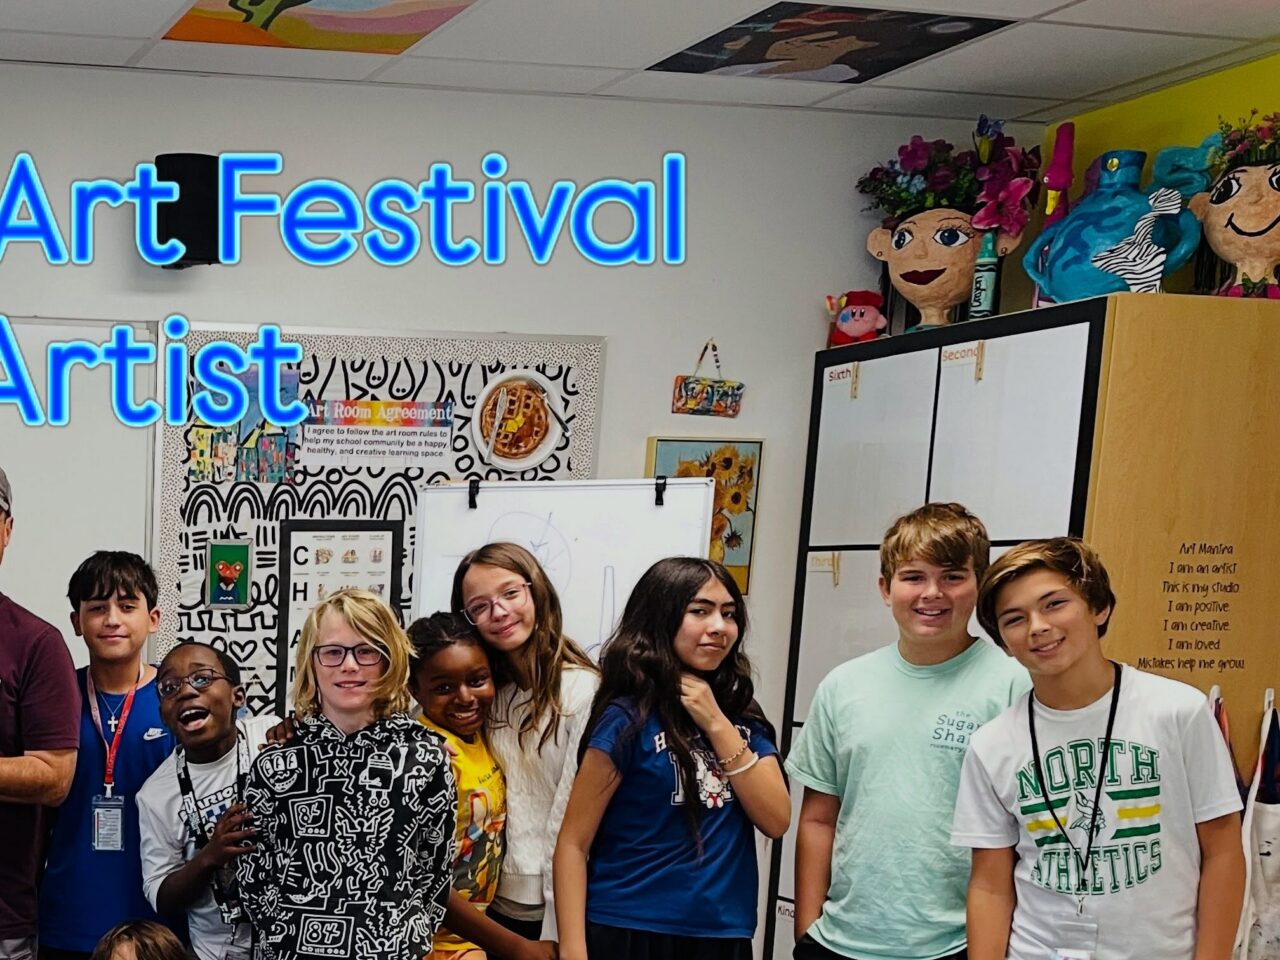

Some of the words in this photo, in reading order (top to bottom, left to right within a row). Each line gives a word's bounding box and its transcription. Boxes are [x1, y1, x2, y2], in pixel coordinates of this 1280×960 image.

[829, 368, 852, 382] Sixth
[308, 403, 329, 418] Art
[333, 403, 371, 419] Room
[378, 404, 454, 422] Agreement
[312, 428, 335, 438] agree
[347, 428, 370, 436] follow
[371, 428, 383, 436] the
[387, 429, 397, 437] art
[419, 429, 438, 438] rules
[439, 430, 448, 438] to
[304, 437, 320, 445] help
[336, 437, 362, 446] school
[364, 438, 404, 447] community
[340, 447, 354, 455] and
[356, 447, 387, 456] creative
[389, 449, 419, 458] learning
[293, 546, 309, 565] C
[1179, 543, 1196, 555] Art
[1199, 543, 1234, 555] Mantra
[1169, 562, 1174, 573] I
[1177, 564, 1194, 573] am
[1196, 564, 1209, 573] an
[1212, 562, 1237, 574] artist
[292, 582, 308, 601] H
[1162, 581, 1180, 592] This
[1182, 582, 1189, 592] is
[1192, 584, 1208, 598] my
[1212, 582, 1240, 593] studio
[1168, 600, 1173, 612] I
[1175, 602, 1192, 612] am
[1194, 601, 1230, 615] positive
[1163, 619, 1168, 631] I
[1171, 621, 1187, 631] am
[1168, 639, 1173, 650] I
[1175, 641, 1192, 650] am
[1137, 658, 1175, 669] Mistakes
[1178, 658, 1195, 672] help
[1199, 659, 1215, 669] me
[1218, 659, 1245, 673] grow
[932, 727, 970, 744] Sha
[1016, 738, 1161, 802] NORTH
[1031, 838, 1162, 895] ATHLETICS
[307, 920, 341, 944] 84
